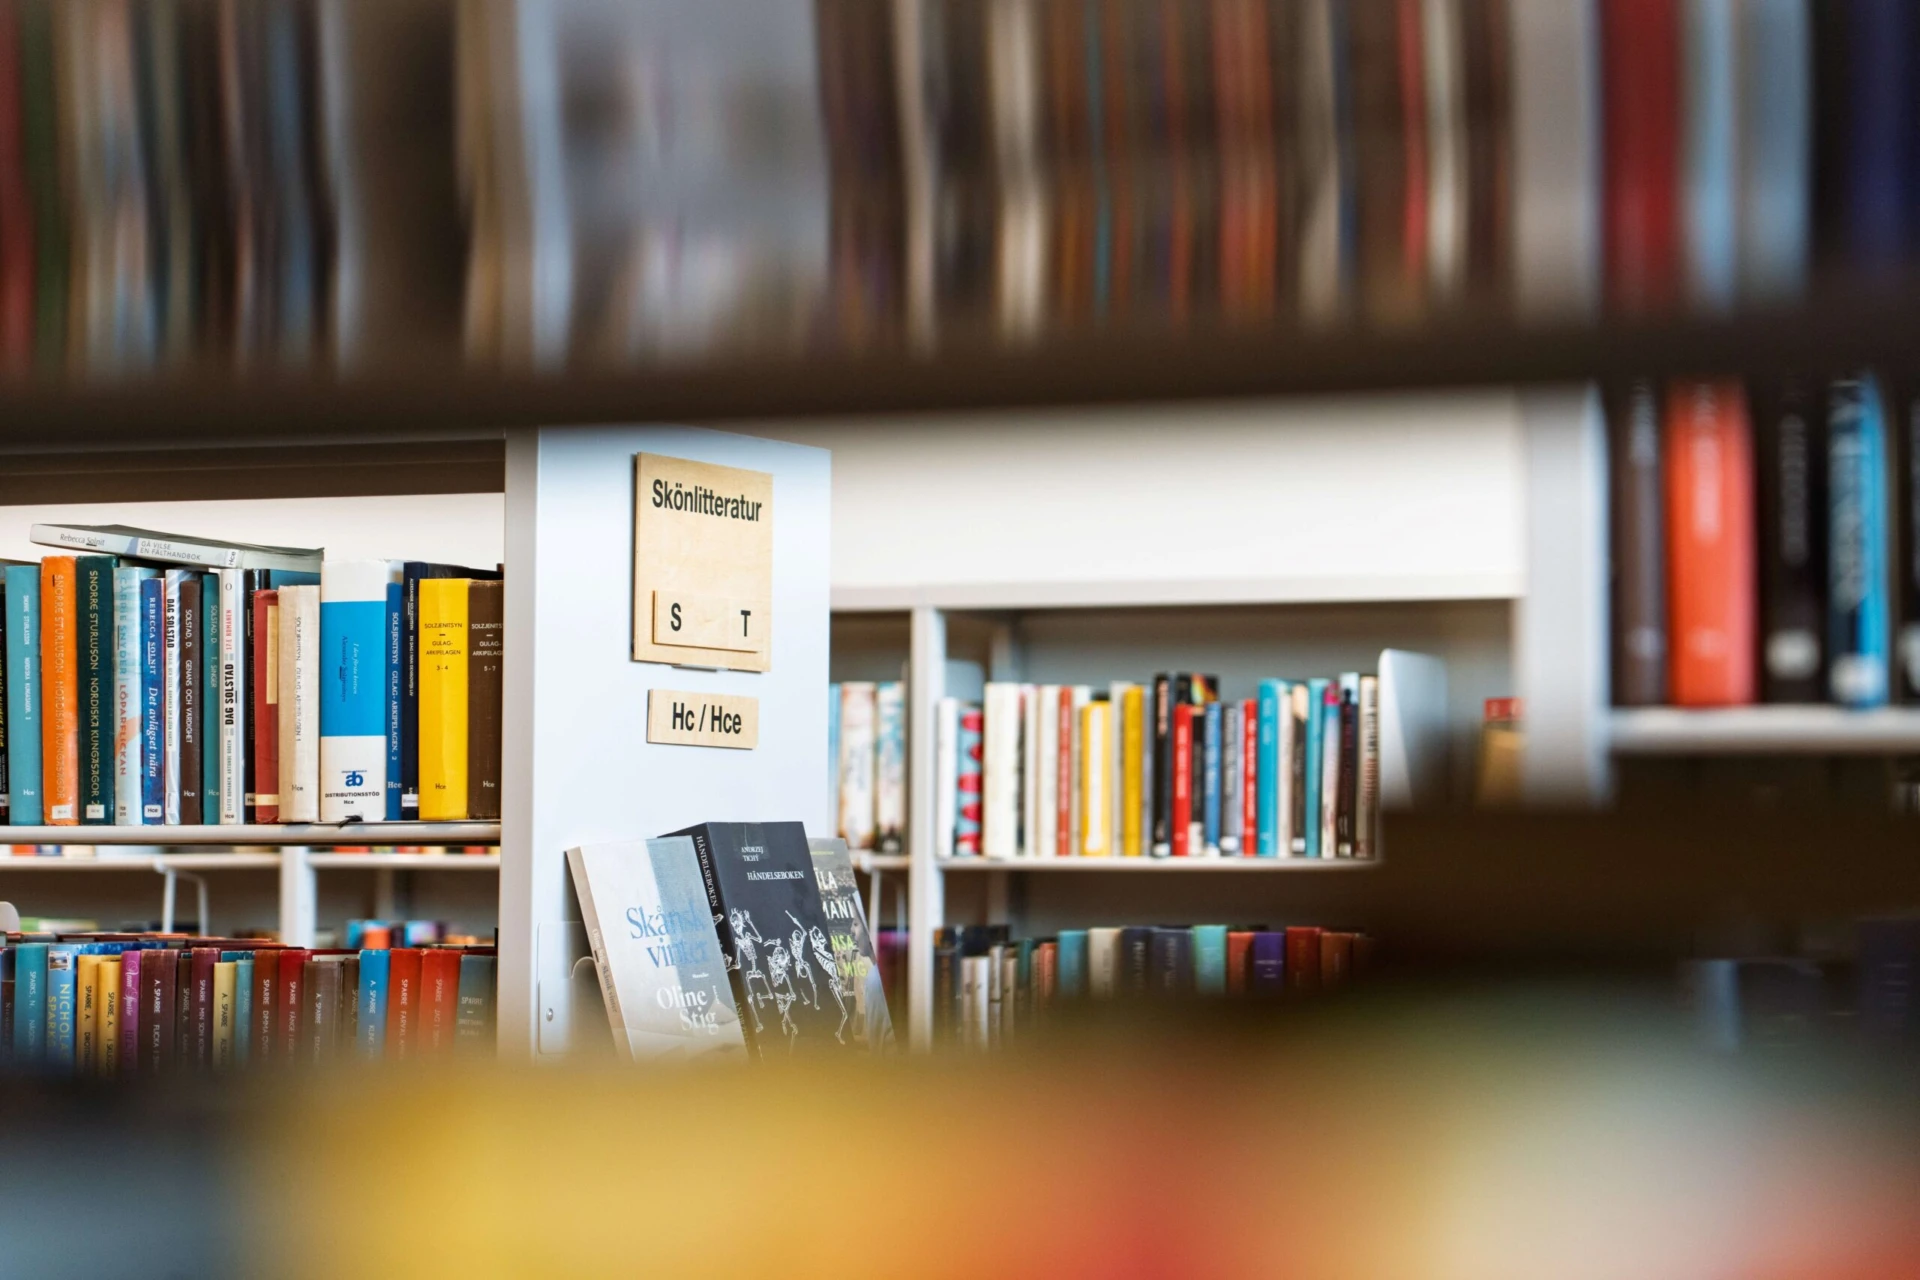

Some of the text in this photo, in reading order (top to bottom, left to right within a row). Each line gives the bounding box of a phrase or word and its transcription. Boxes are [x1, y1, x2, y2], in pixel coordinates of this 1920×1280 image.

[652, 479, 762, 522] Skönlitteratur
[60, 533, 104, 546] Rebecca Solnit
[153, 542, 171, 550] VILSE
[227, 551, 236, 566] Hce
[54, 574, 64, 613] SNORRE
[89, 570, 99, 610] SNORRE
[670, 602, 751, 637] S T
[54, 616, 64, 673] STURLUSON
[90, 613, 99, 670] STURLUSON
[185, 641, 192, 649] D.
[210, 637, 217, 645] D.
[119, 575, 128, 774] CARRIE SNYDER LÖPARFLICKAN
[55, 681, 65, 730] NORDISKA
[90, 678, 100, 727] NORDISKA
[225, 664, 234, 725] DAG SOLSTAD
[147, 687, 158, 777] Det avlägset nära
[185, 708, 193, 744] VÄRDIGHET
[672, 702, 695, 732] Hc
[711, 705, 742, 734] Hce
[56, 733, 65, 799] KUNGASAGOR
[90, 730, 100, 797] KUNGASAGOR
[346, 770, 363, 787] ab
[387, 781, 402, 789] Hce
[482, 780, 495, 788] Hce
[741, 846, 764, 854] ANDRZEJ
[696, 835, 719, 907] HÄNDELSEBOKEN
[746, 870, 804, 881] HÄNDELSEBOKEN
[626, 898, 708, 939] Skånsk
[646, 937, 709, 968] vinter
[153, 979, 161, 987] A.
[289, 981, 297, 1005] SPARRE
[656, 985, 707, 1010] Oline
[84, 985, 92, 1022] SPARRE, A.
[153, 988, 161, 1014] SPARRE
[182, 987, 190, 1013] SPARRE,
[369, 990, 377, 1014] SPARRE
[461, 996, 483, 1006] SPARRE
[680, 1004, 719, 1035] Stig
